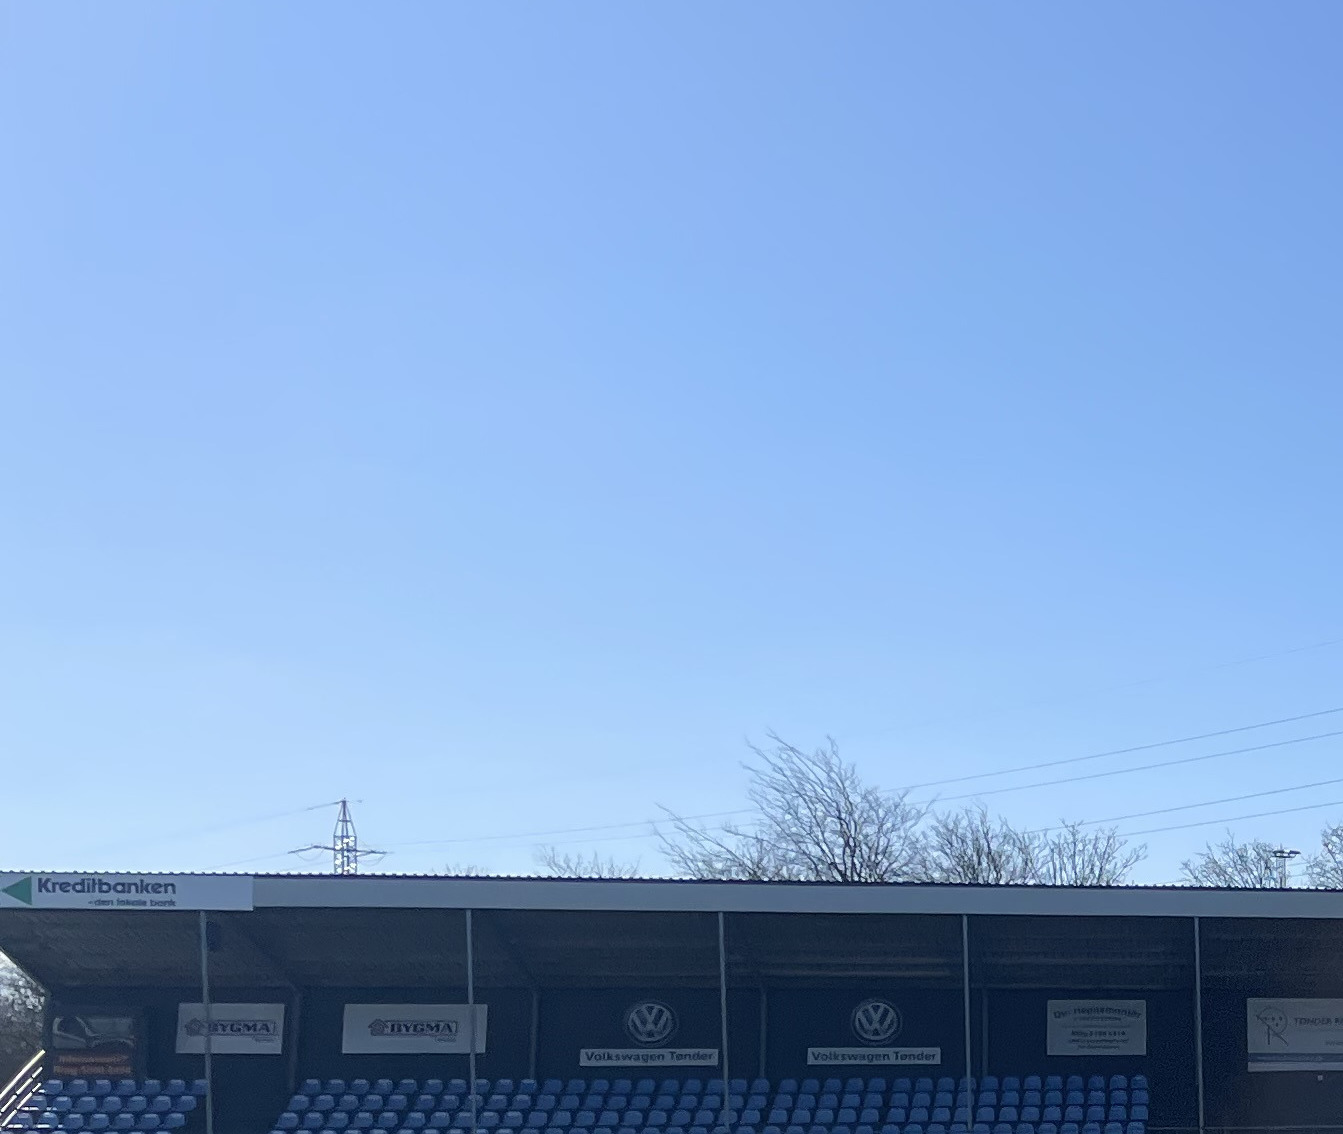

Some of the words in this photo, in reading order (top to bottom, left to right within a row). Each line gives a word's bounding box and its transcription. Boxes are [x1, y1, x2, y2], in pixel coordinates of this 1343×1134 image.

[38, 877, 176, 895] Kreditbanken
[390, 1022, 453, 1033] BYGMA
[584, 1051, 665, 1063] Volkswagen
[669, 1051, 714, 1061] Tønder
[811, 1050, 890, 1063] Volkswagen
[893, 1051, 937, 1061] Tønder
